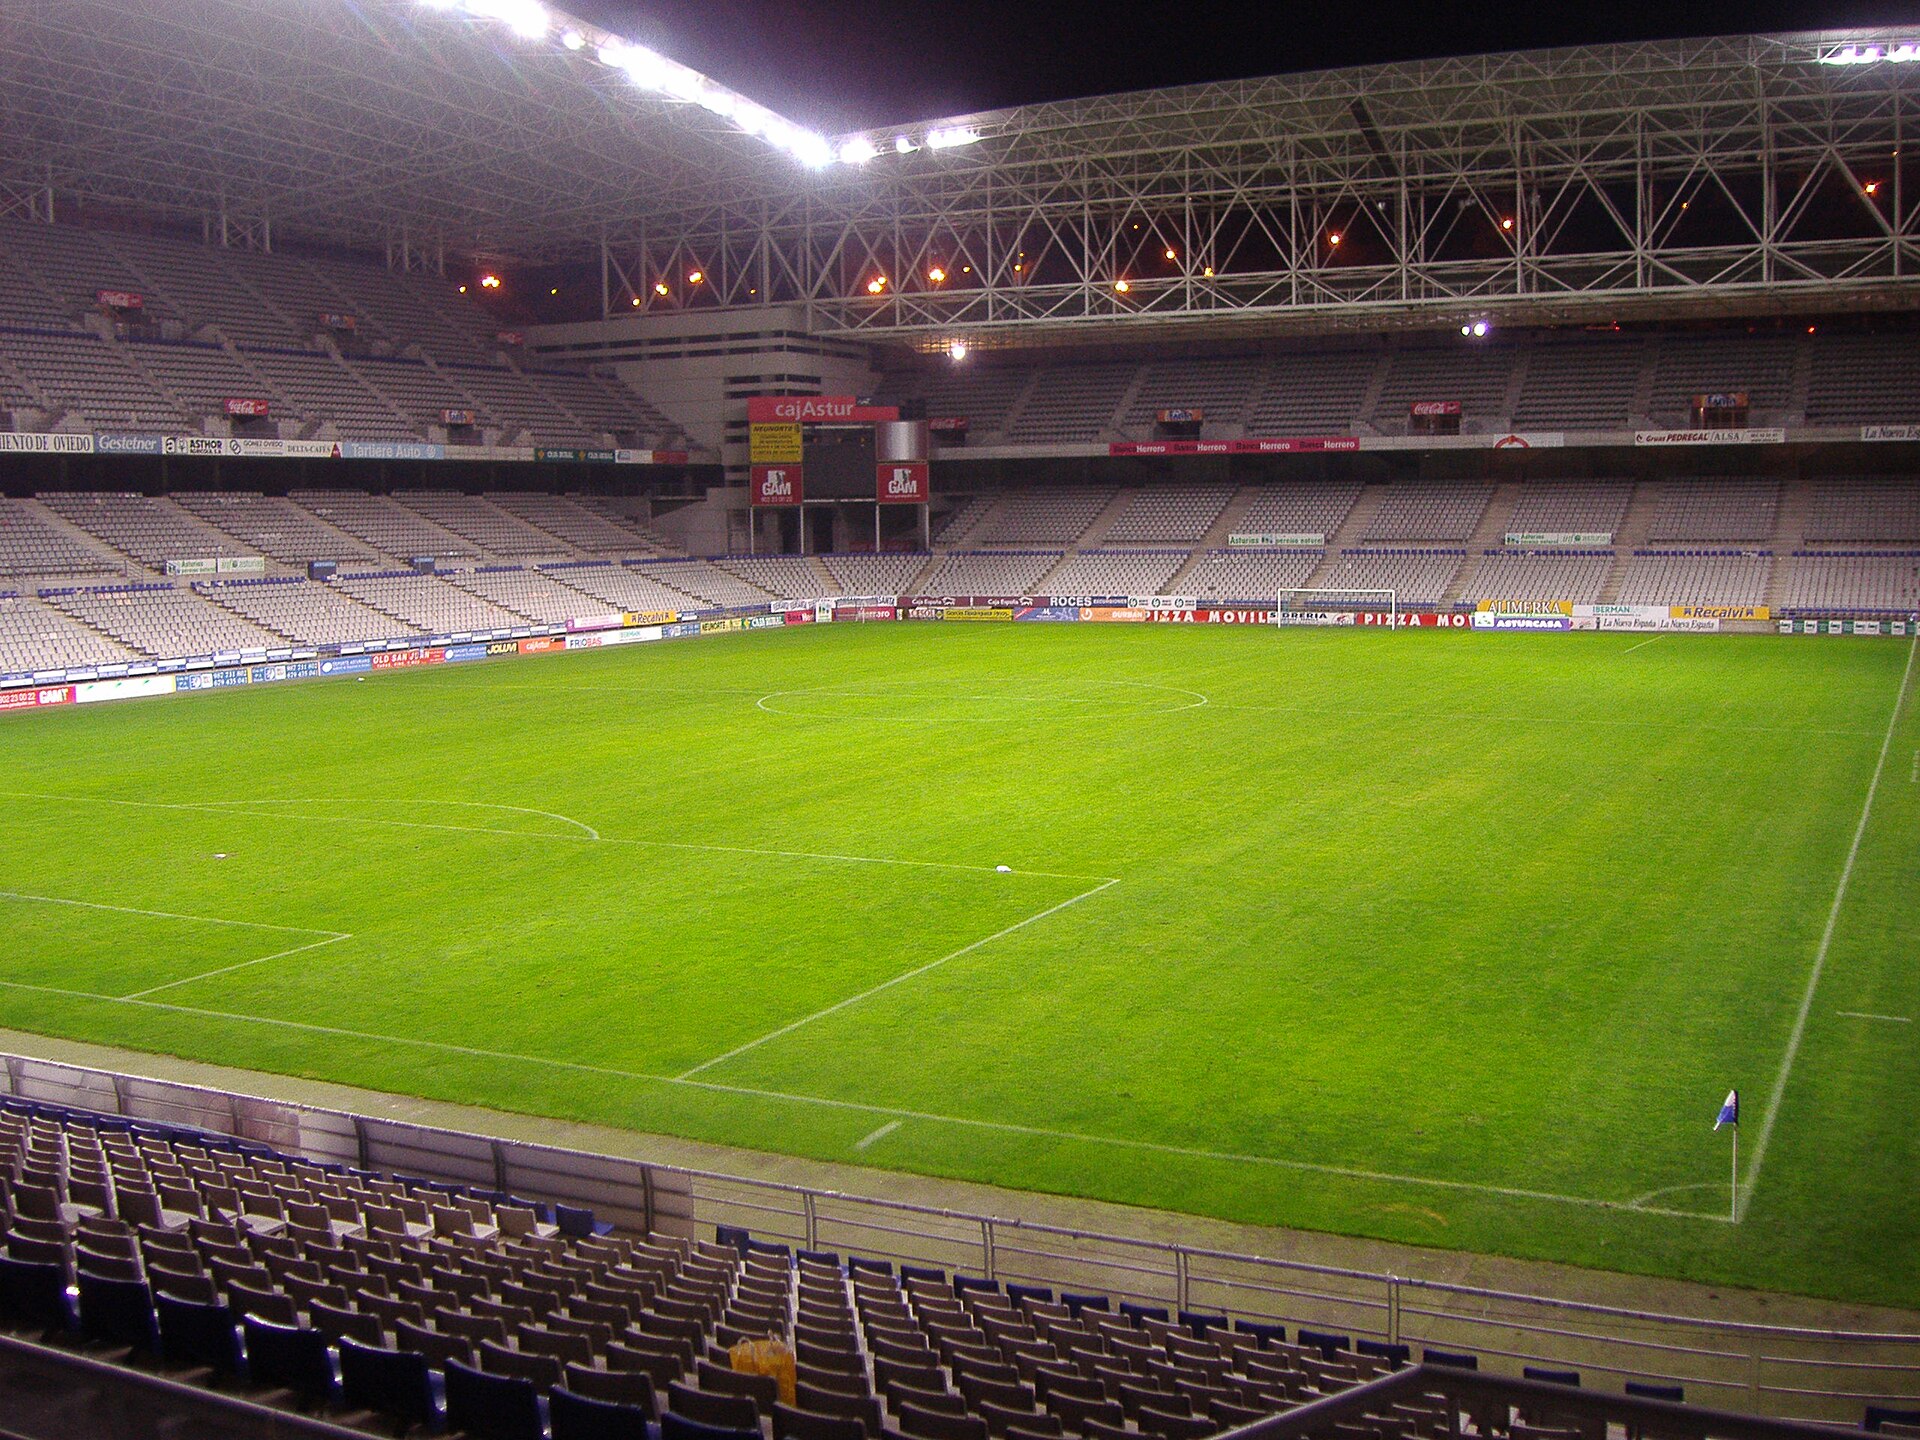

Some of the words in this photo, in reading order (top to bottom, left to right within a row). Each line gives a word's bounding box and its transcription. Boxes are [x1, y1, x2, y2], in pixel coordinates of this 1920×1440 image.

[774, 401, 855, 421] cajAstur
[35, 434, 48, 451] DE
[53, 435, 91, 452] OVIEDO
[99, 435, 157, 451] Gestetner
[189, 440, 223, 449] ASTHOR
[1136, 444, 1166, 453] Herrero
[1197, 443, 1227, 452] Herrero
[1260, 442, 1290, 450] Herrero
[1323, 440, 1355, 449] Herrero
[351, 443, 393, 458] Tartiere
[395, 445, 421, 458] Auto
[762, 482, 792, 496] GAM
[888, 480, 917, 494] GAM
[1050, 597, 1092, 607] ROCES
[1488, 601, 1561, 613] ALIMERKA
[637, 612, 664, 624] Recalvi
[1208, 611, 1268, 623] MOVIL
[1269, 612, 1328, 620] SDRERIA
[1693, 607, 1744, 618] Recalvi
[1497, 619, 1563, 628] ASTURCASA
[1603, 618, 1613, 627] La
[570, 637, 602, 648] FRIOBAS
[373, 655, 390, 664] OLD
[391, 653, 408, 662] SAN
[28, 691, 36, 701] 22
